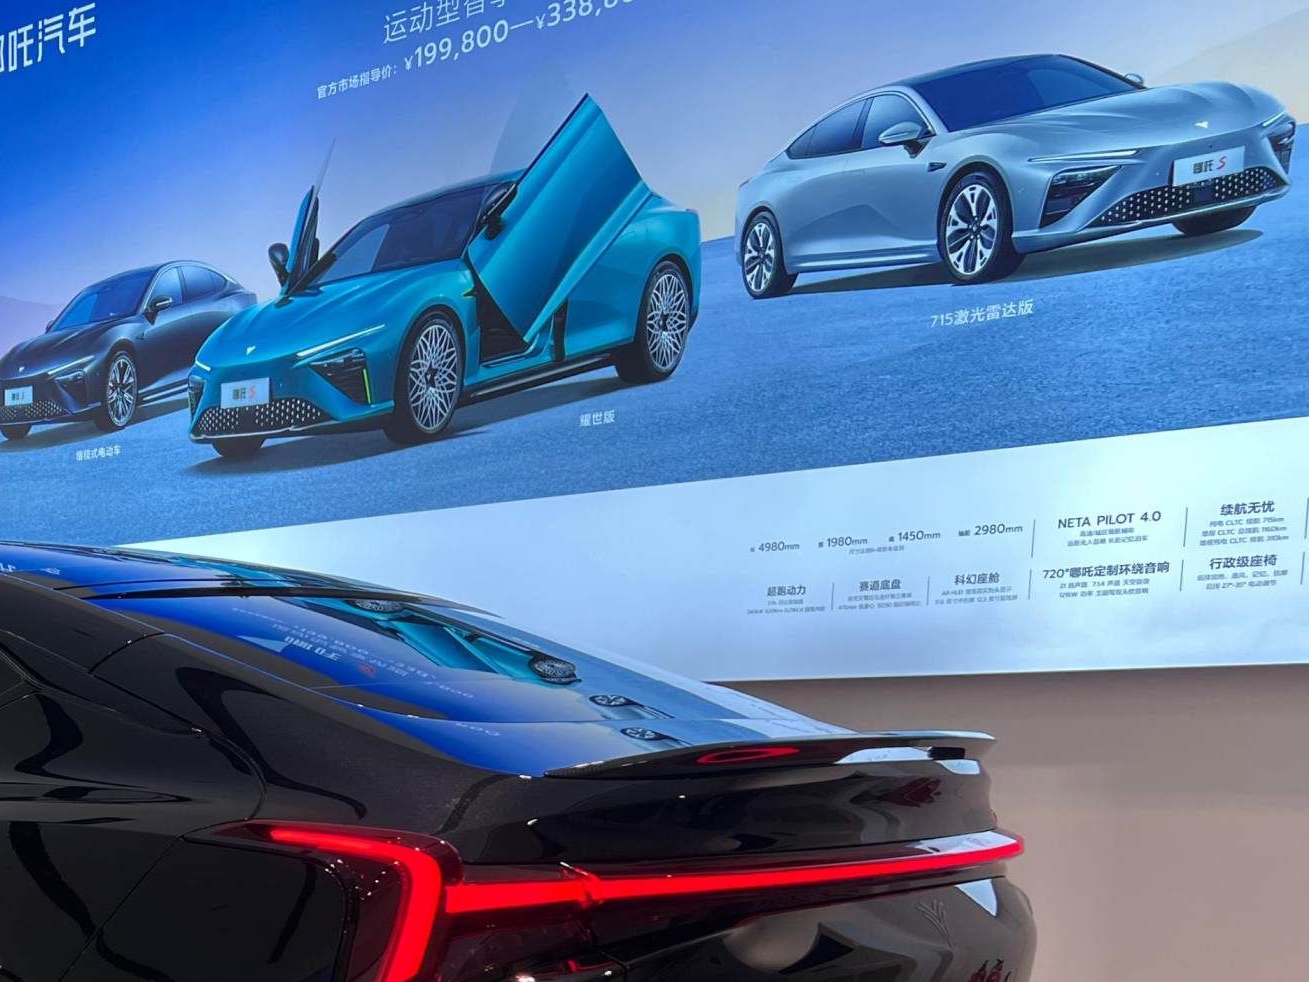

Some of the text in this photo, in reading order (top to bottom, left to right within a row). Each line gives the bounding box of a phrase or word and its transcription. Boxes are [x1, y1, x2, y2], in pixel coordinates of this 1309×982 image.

[382, 0, 505, 44] 运动型
[1215, 155, 1228, 170] S
[931, 299, 1034, 328] 715激光雷达版
[1220, 500, 1276, 516] 续航无忧
[1058, 511, 1162, 529] NETA PILOT 4.0
[898, 530, 941, 542] 1450mm
[974, 523, 1023, 536] 2980mm
[758, 541, 800, 553] 4980mm
[827, 536, 868, 548] 1980mm
[1209, 554, 1277, 570] 行政级座椅
[1043, 561, 1170, 579] 720°哪吒定制环绕音响
[859, 579, 901, 592] 赛道底盘
[954, 572, 1000, 586] 科幻座舱
[767, 585, 806, 597] 超跑动力
